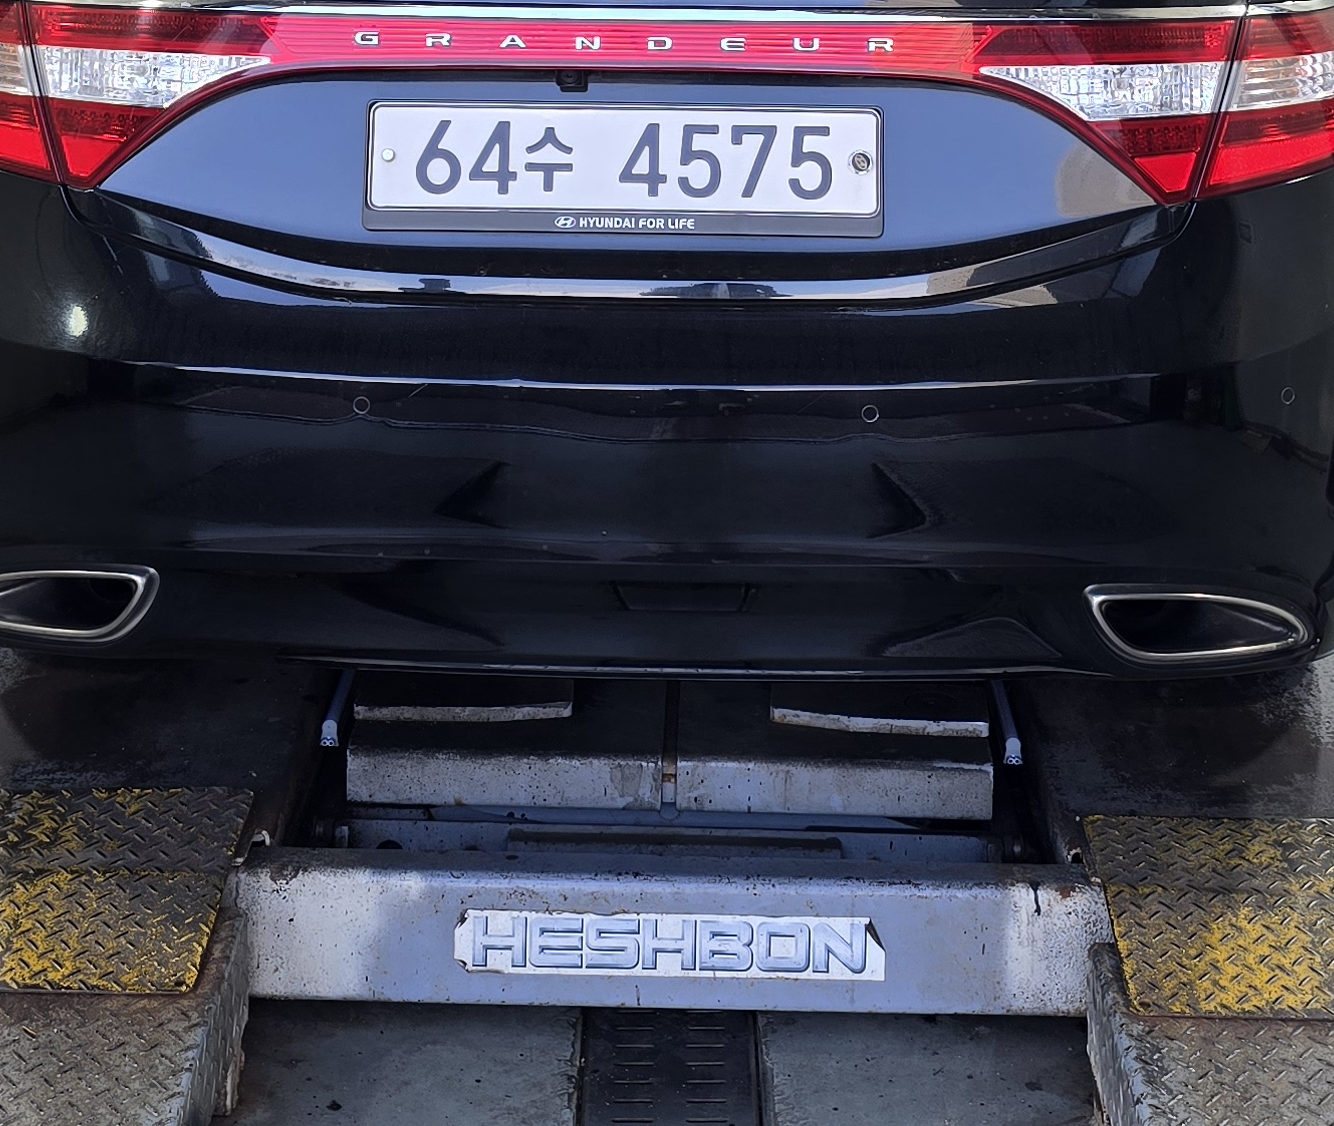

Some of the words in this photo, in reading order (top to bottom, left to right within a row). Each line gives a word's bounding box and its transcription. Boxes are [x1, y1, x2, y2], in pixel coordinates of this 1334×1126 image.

[353, 29, 895, 53] GRANDEUR
[415, 119, 574, 195] 64수
[618, 122, 833, 200] 4575
[579, 217, 635, 228] HYUNDAI
[638, 217, 665, 229] FOR
[667, 218, 695, 230] LIFE
[471, 916, 867, 973] HESHBON
